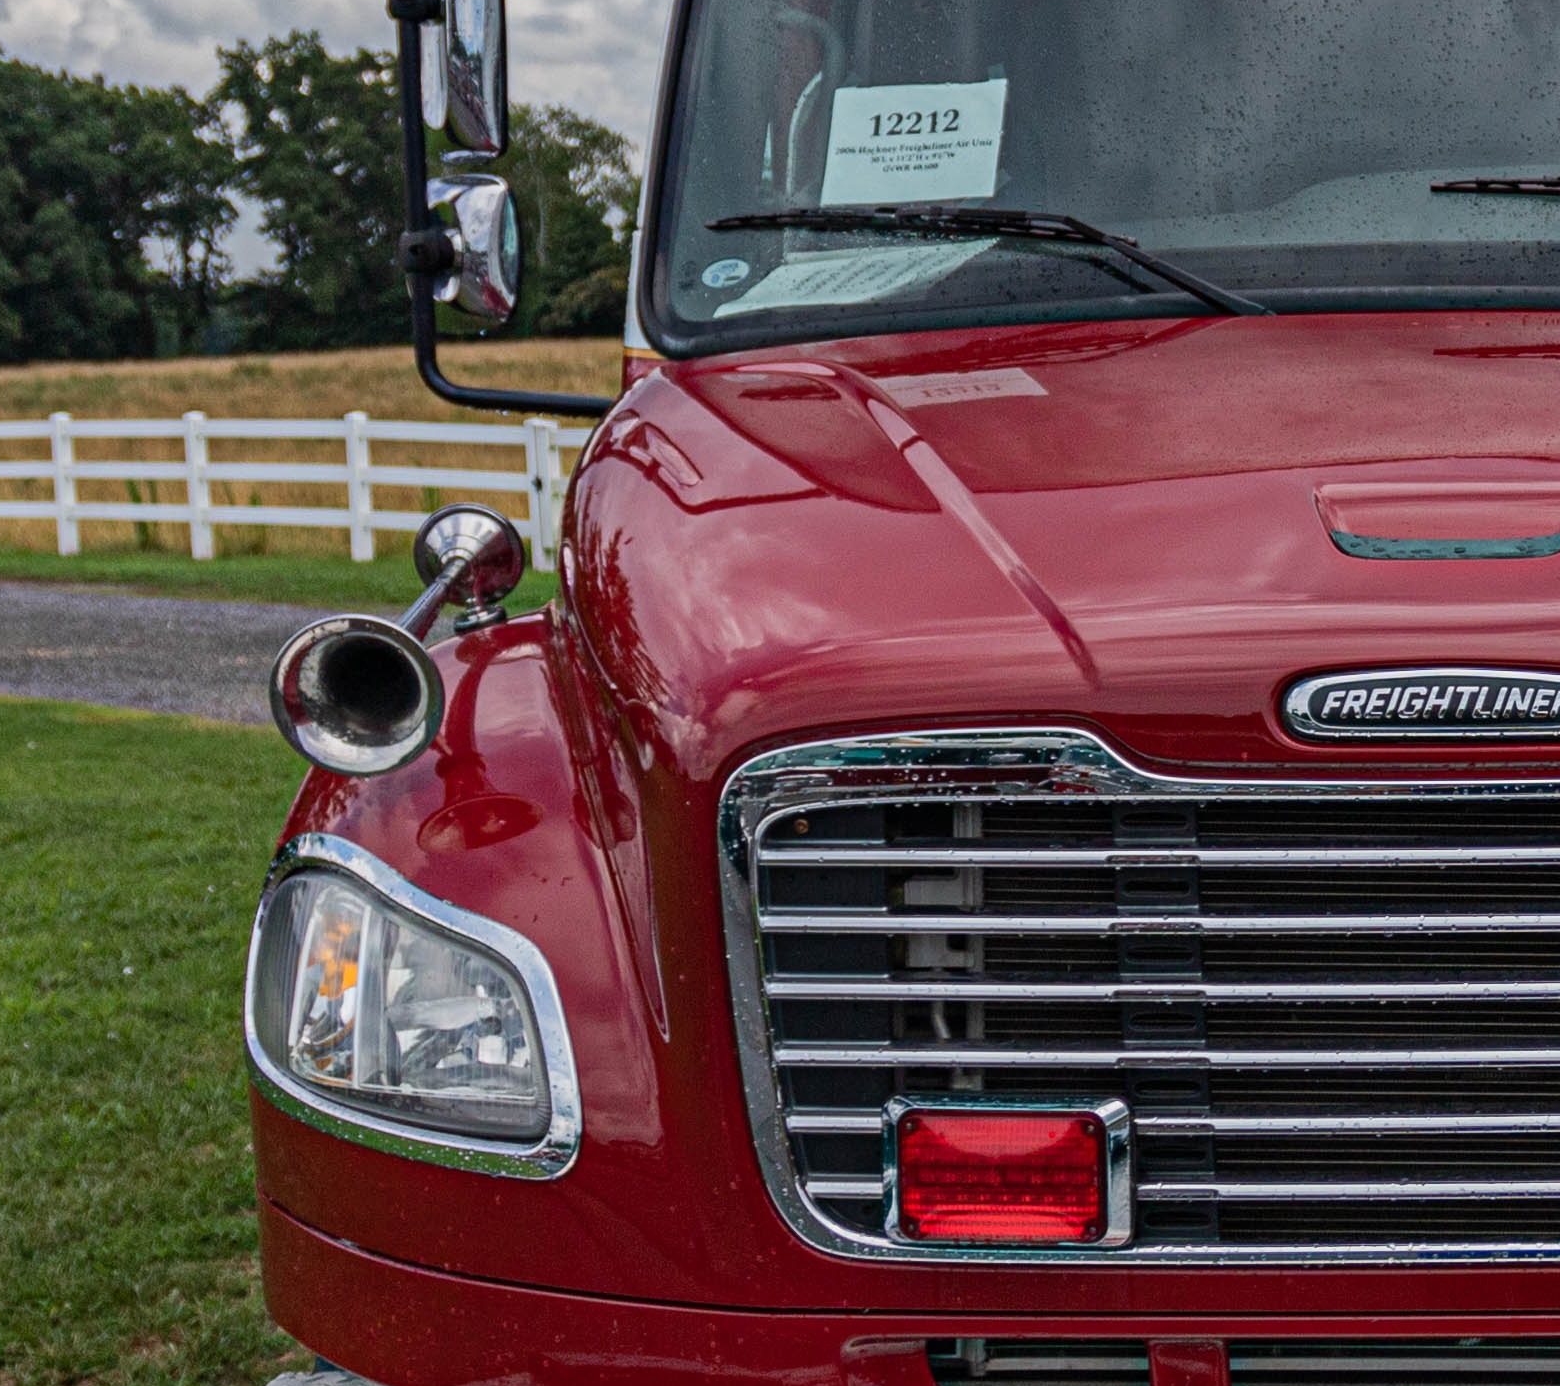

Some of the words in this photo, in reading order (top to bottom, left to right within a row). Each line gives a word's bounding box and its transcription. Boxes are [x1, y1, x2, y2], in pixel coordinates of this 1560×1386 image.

[870, 109, 960, 137] 12212
[899, 141, 952, 152] Freightliner
[955, 140, 969, 148] Air
[972, 139, 992, 147] Unit
